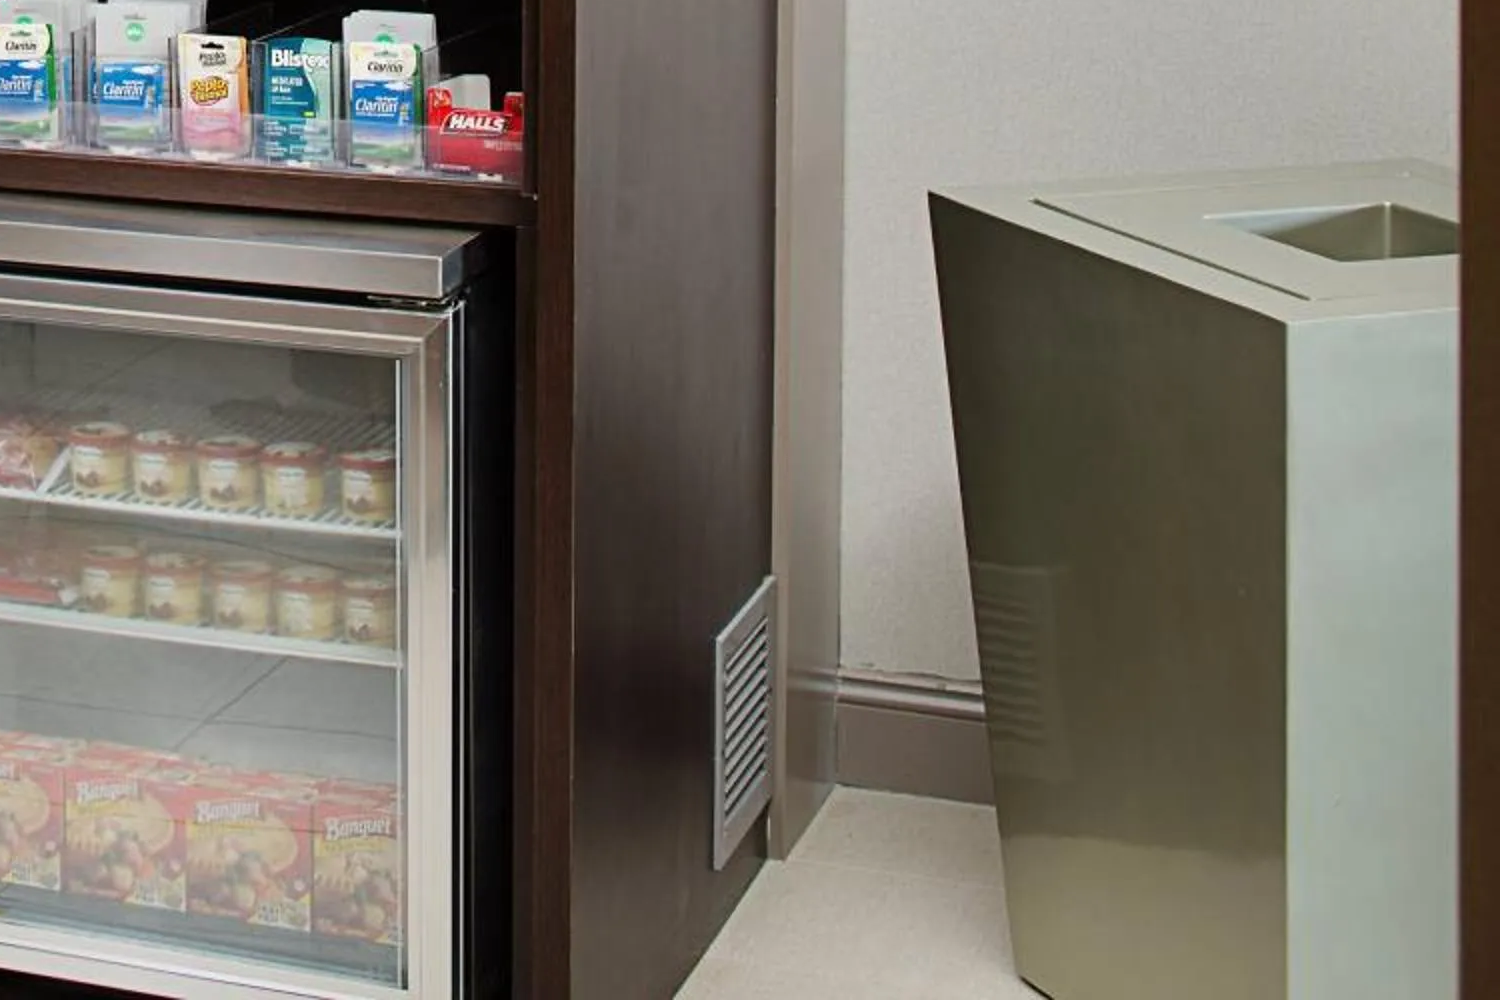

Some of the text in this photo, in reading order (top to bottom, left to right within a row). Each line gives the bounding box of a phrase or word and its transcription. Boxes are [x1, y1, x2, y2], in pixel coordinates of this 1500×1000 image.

[271, 48, 331, 72] Blistex
[449, 112, 506, 132] HALLS
[325, 816, 391, 841] Banquet
